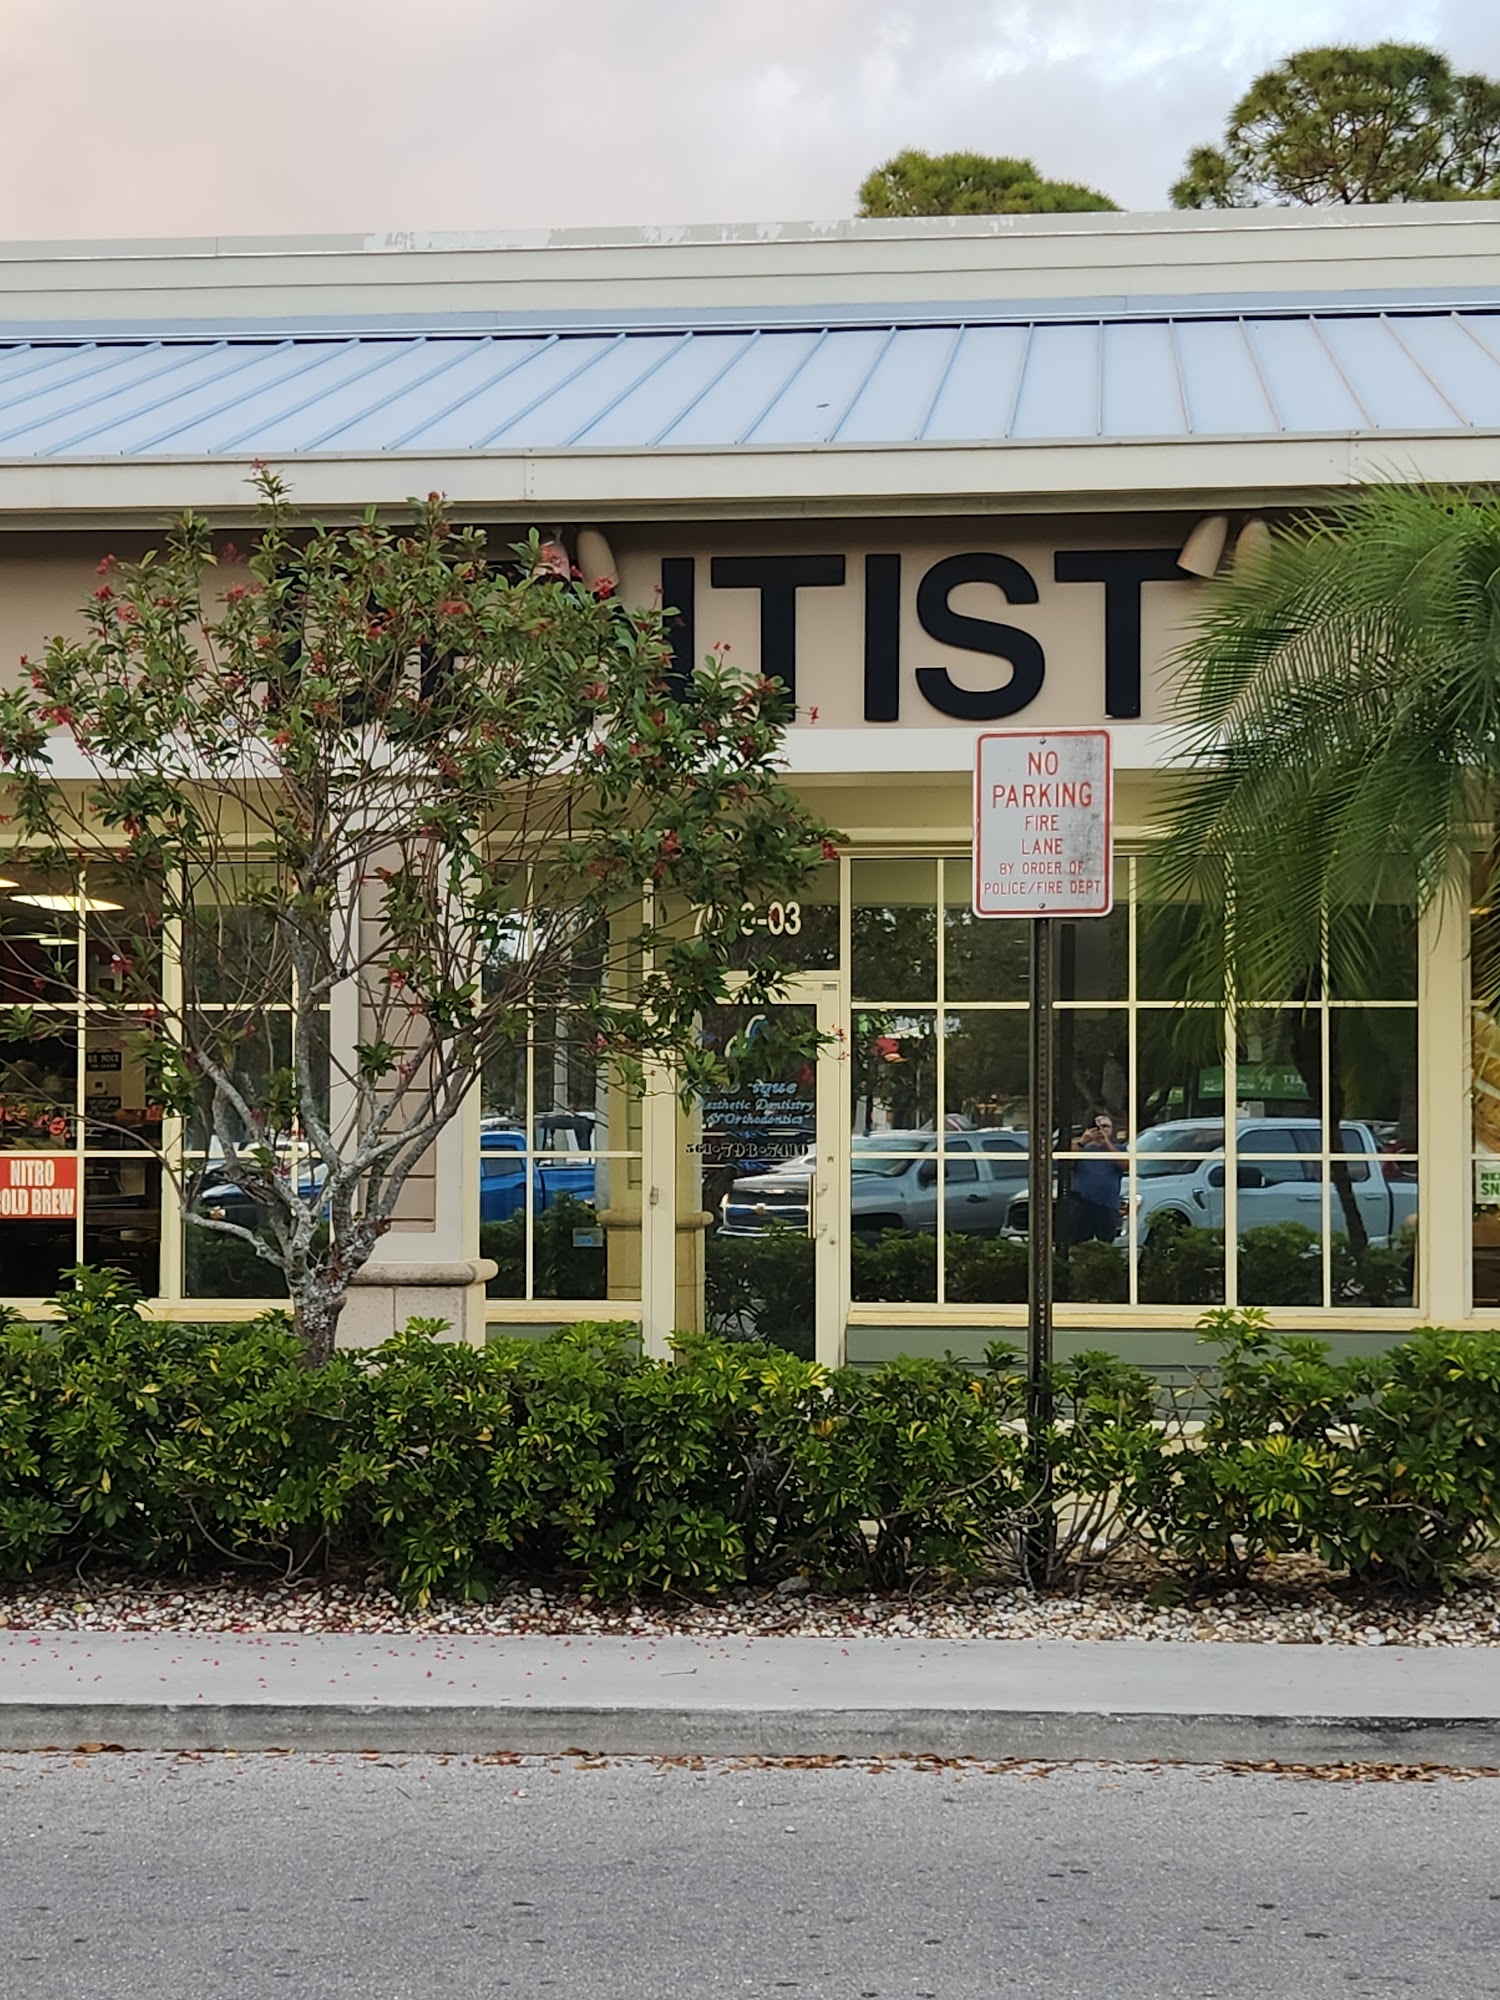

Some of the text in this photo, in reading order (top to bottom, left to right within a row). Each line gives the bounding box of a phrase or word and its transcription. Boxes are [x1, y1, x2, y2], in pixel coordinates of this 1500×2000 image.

[1028, 750, 1059, 776] NO
[992, 782, 1093, 809] PARKING
[1025, 814, 1060, 832] FIRE
[1022, 838, 1064, 855] LANE
[1000, 860, 1085, 876] BY ORDER OF
[984, 880, 1101, 895] POLICE/FIRE DEPT
[755, 1098, 815, 1113] Dentistry
[10, 1159, 55, 1187] NITRO
[0, 1188, 75, 1215] OLD BREW
